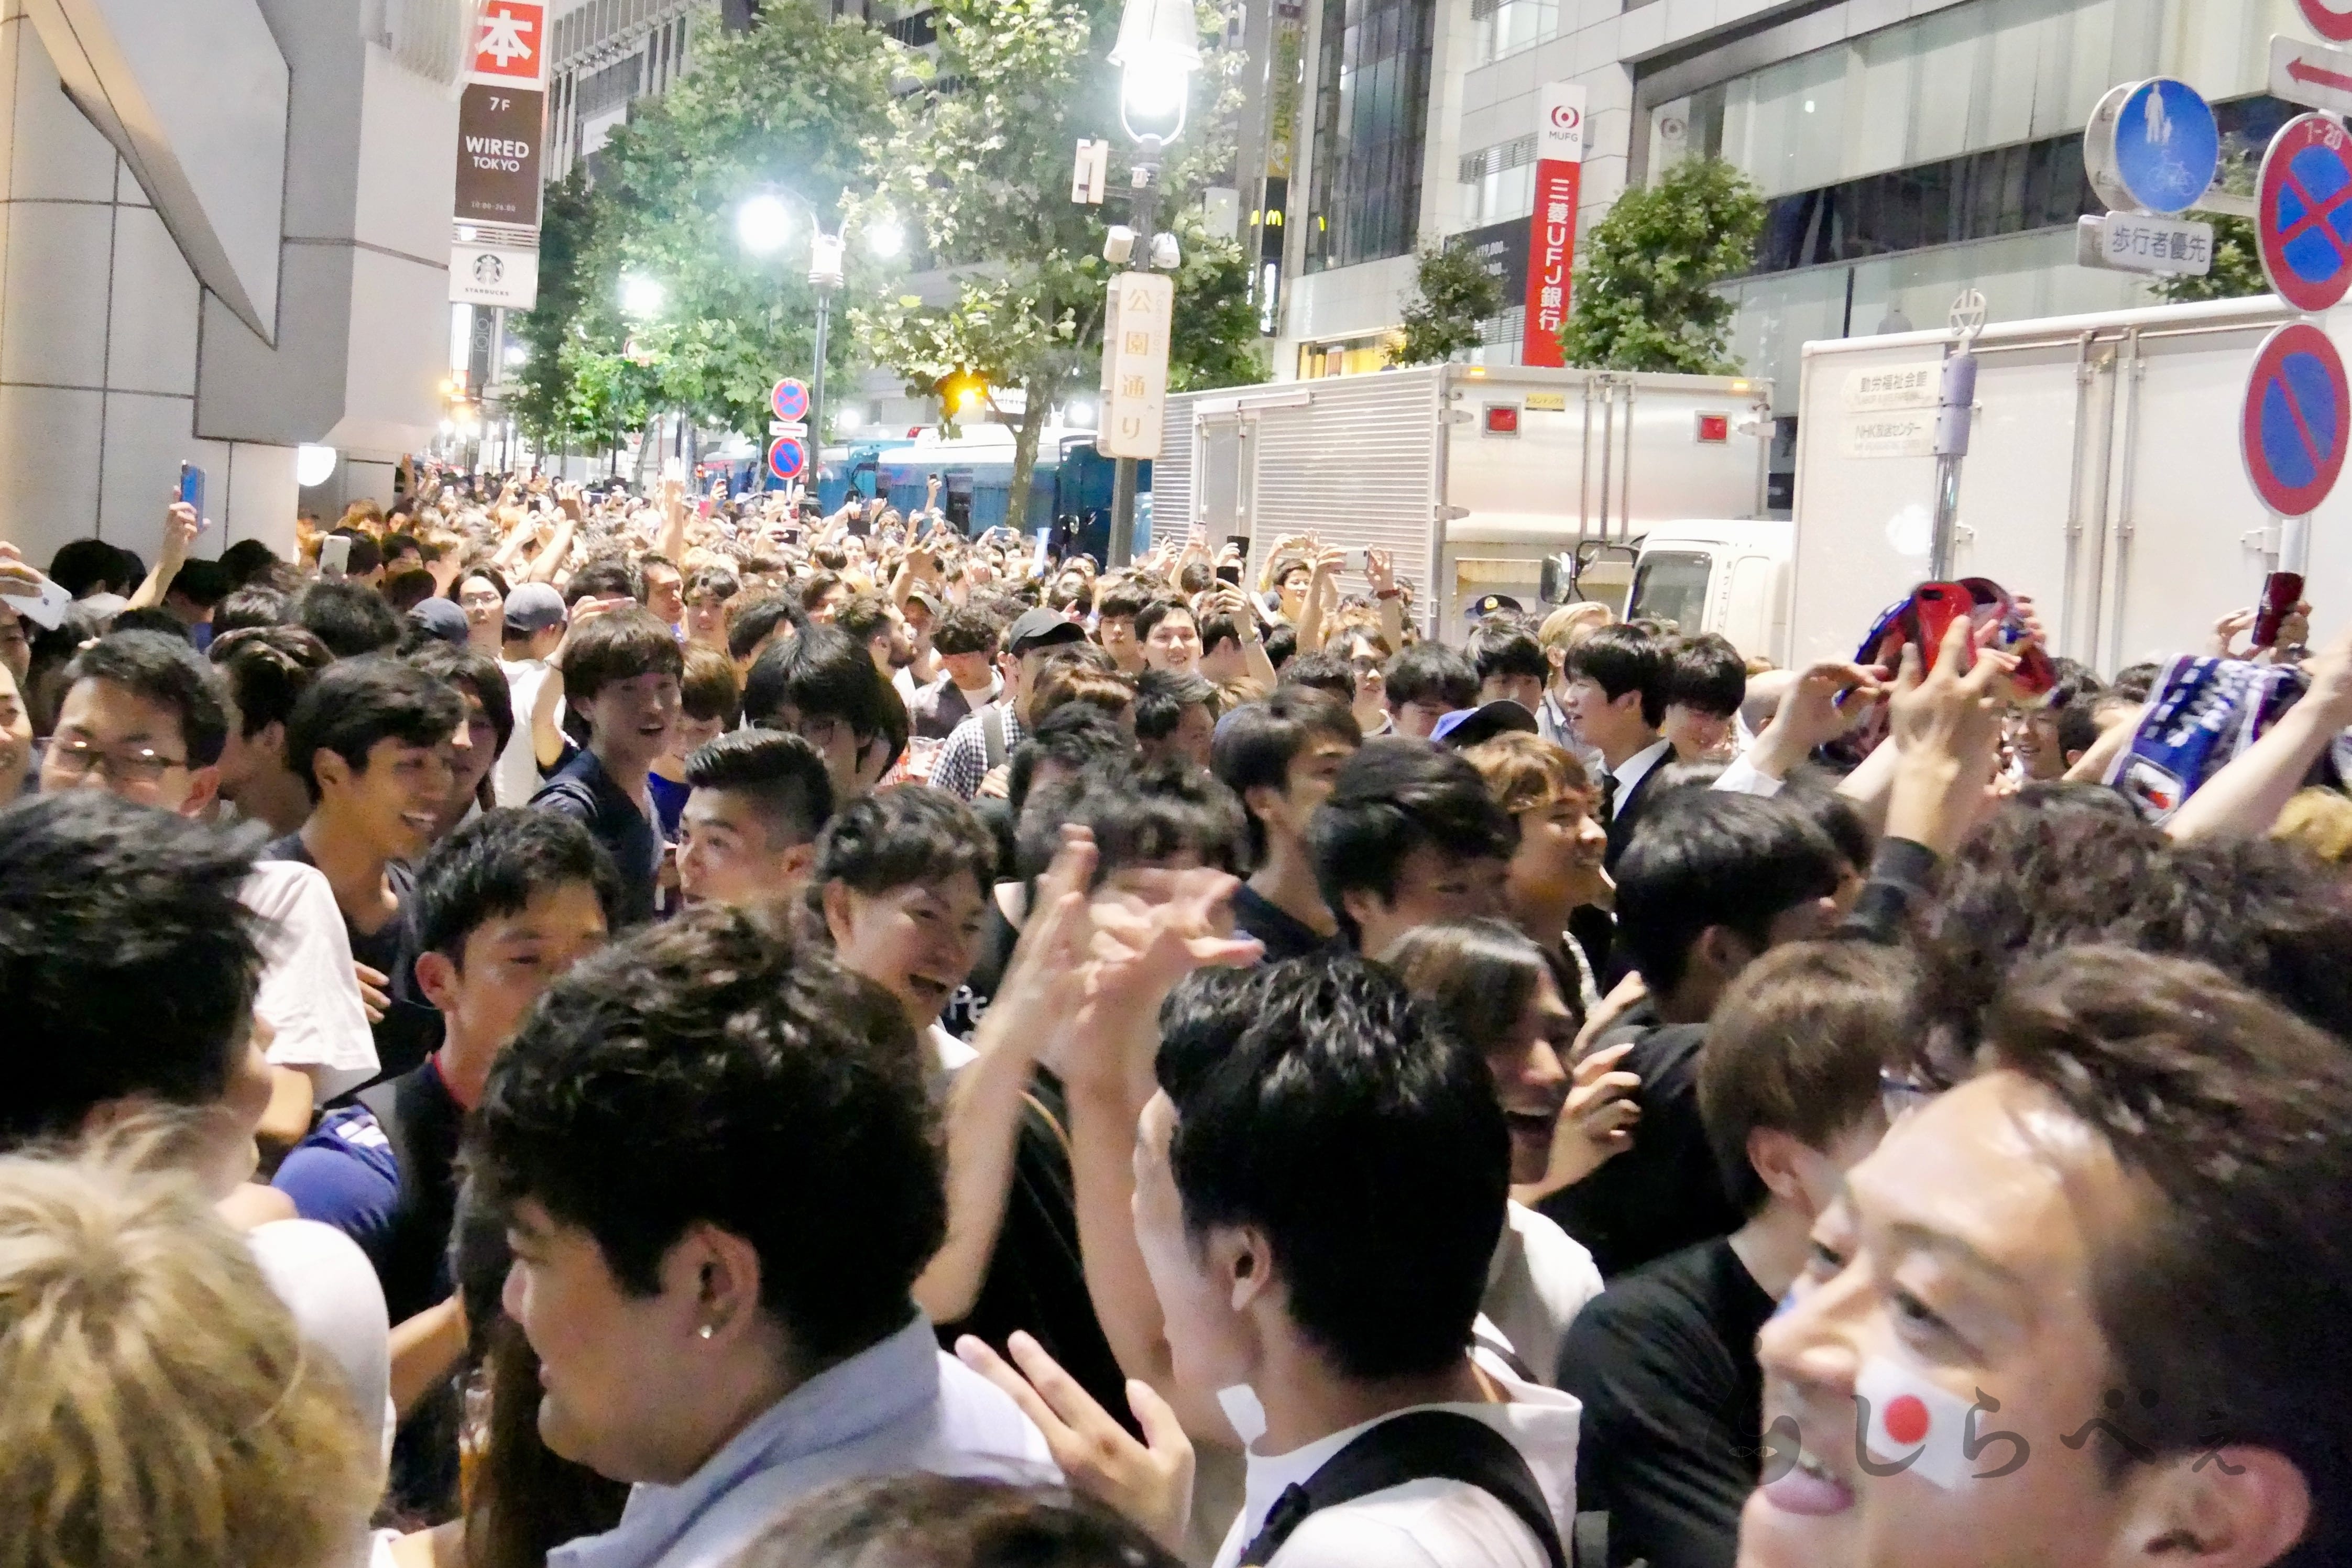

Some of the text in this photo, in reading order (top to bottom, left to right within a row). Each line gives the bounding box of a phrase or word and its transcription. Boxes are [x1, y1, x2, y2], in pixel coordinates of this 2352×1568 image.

[476, 9, 533, 68] 本
[489, 96, 511, 112] 7F
[465, 135, 529, 159] WIRED
[1549, 131, 1578, 142] MUFG
[473, 156, 520, 173] TOKYO
[1539, 178, 1570, 332] 三菱UFJ銀行
[2112, 224, 2207, 263] 歩行者優先
[465, 287, 510, 297] STARBUCKS
[1121, 288, 1152, 440] 公園通り
[1860, 370, 1928, 392] 勤労福祉会館
